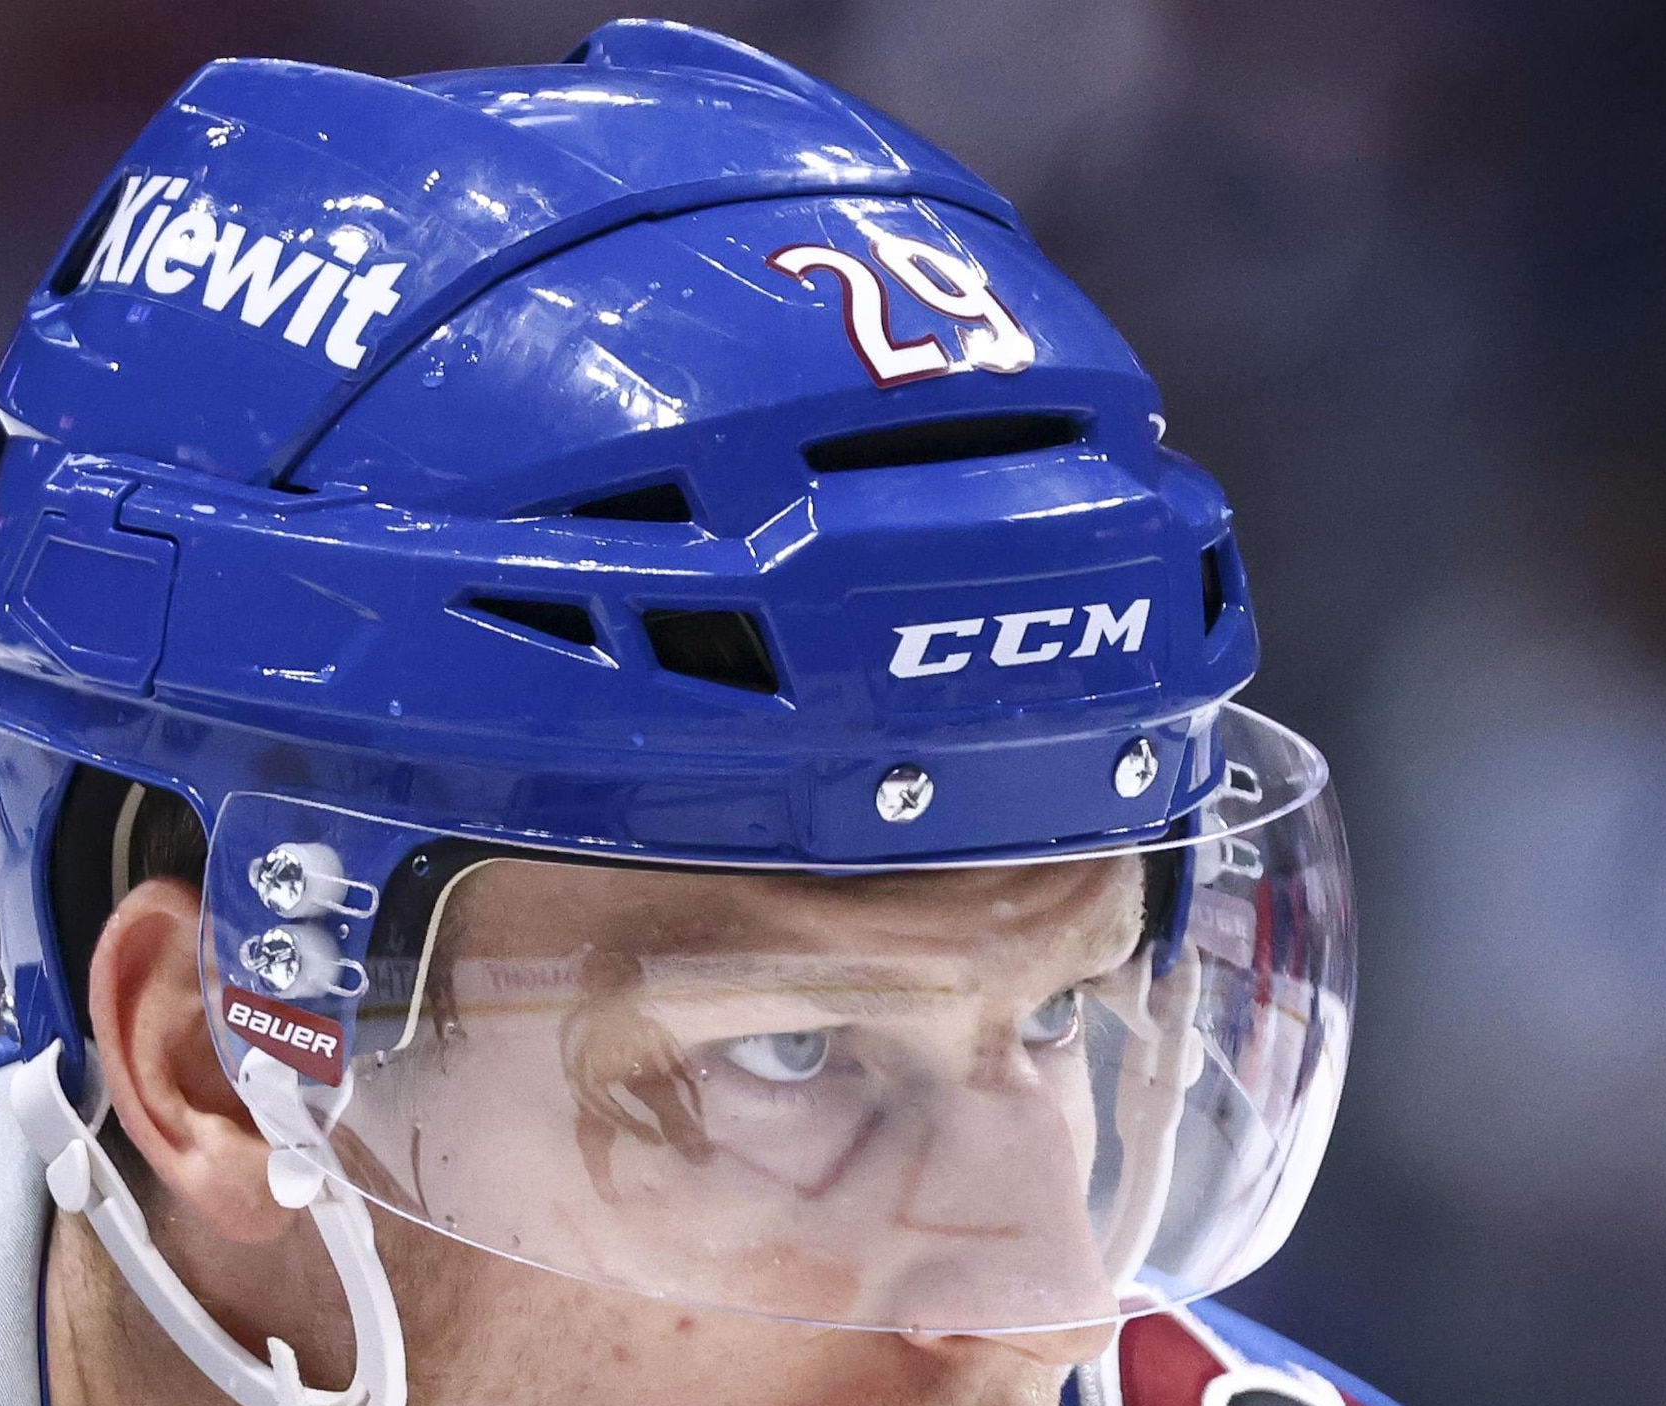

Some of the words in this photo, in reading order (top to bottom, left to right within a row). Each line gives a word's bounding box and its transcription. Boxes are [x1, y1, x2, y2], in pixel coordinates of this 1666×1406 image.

[82, 174, 406, 370] Kiewit
[766, 242, 1035, 390] 29
[888, 598, 1151, 678] CCM
